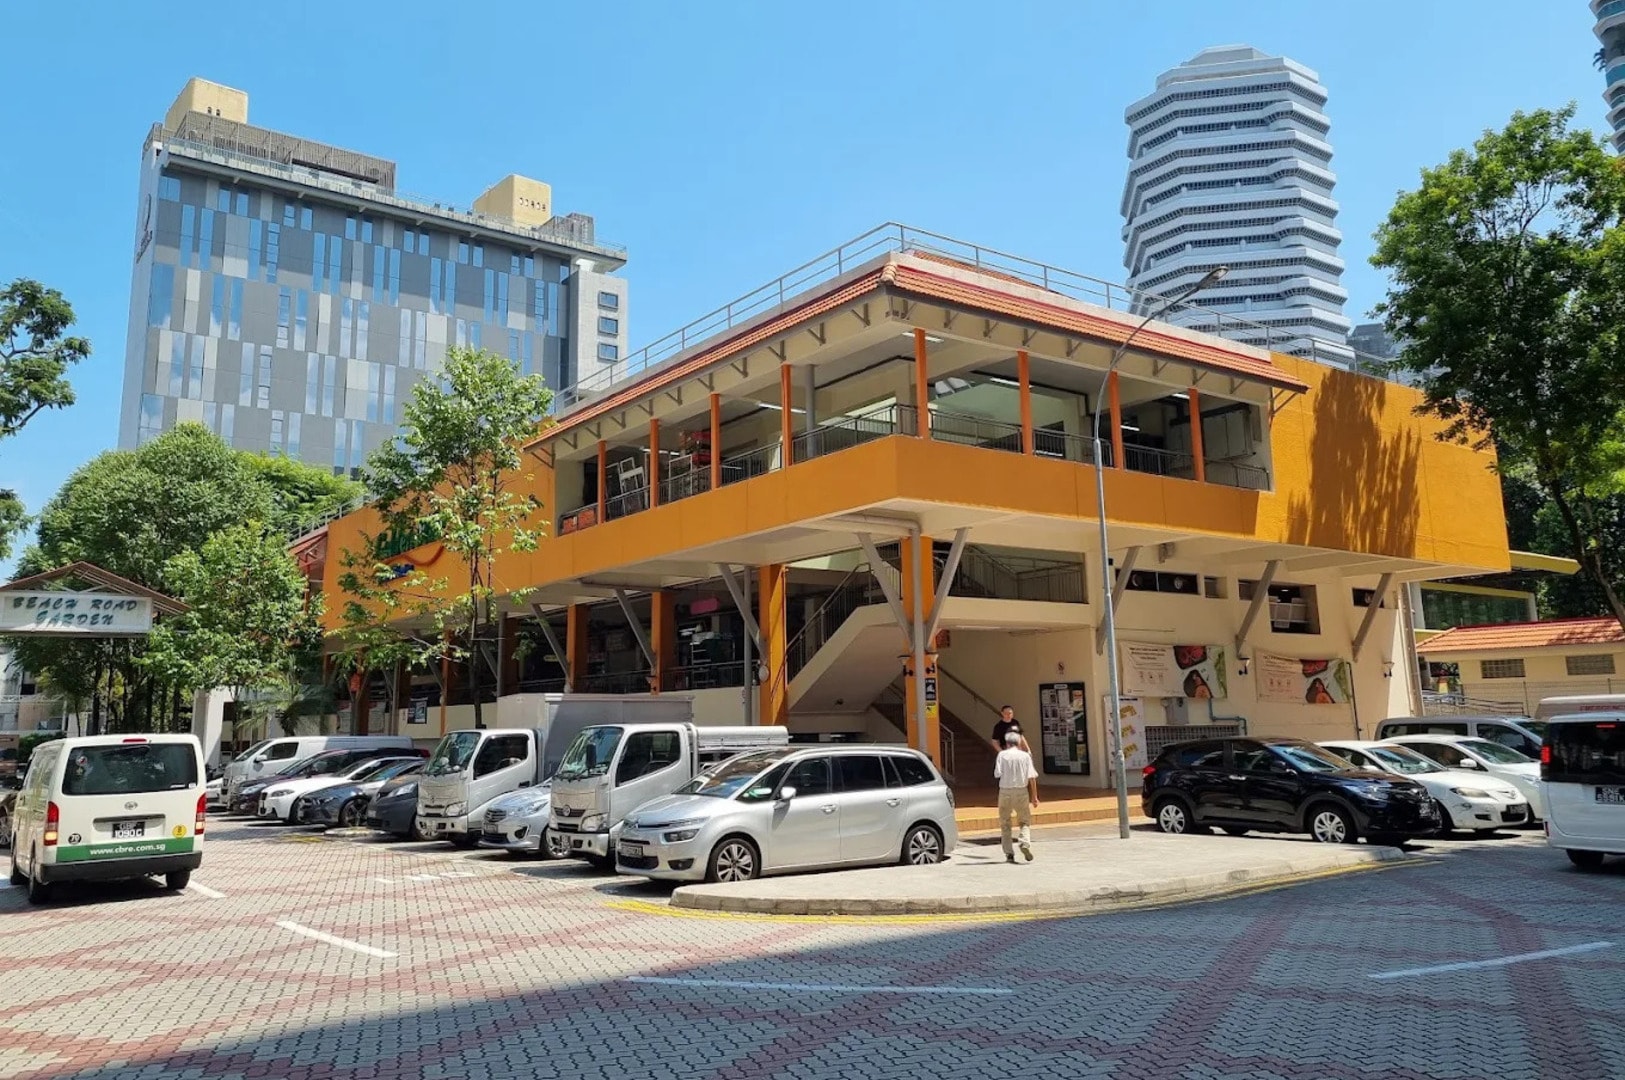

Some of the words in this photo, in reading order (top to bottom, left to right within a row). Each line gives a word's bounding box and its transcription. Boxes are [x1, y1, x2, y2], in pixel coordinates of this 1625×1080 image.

[13, 596, 79, 609] BEACH
[90, 598, 138, 611] ROAD
[36, 610, 114, 626] GARDEN
[115, 829, 142, 838] 1090C
[90, 843, 165, 854] www.cbre.com.sg
